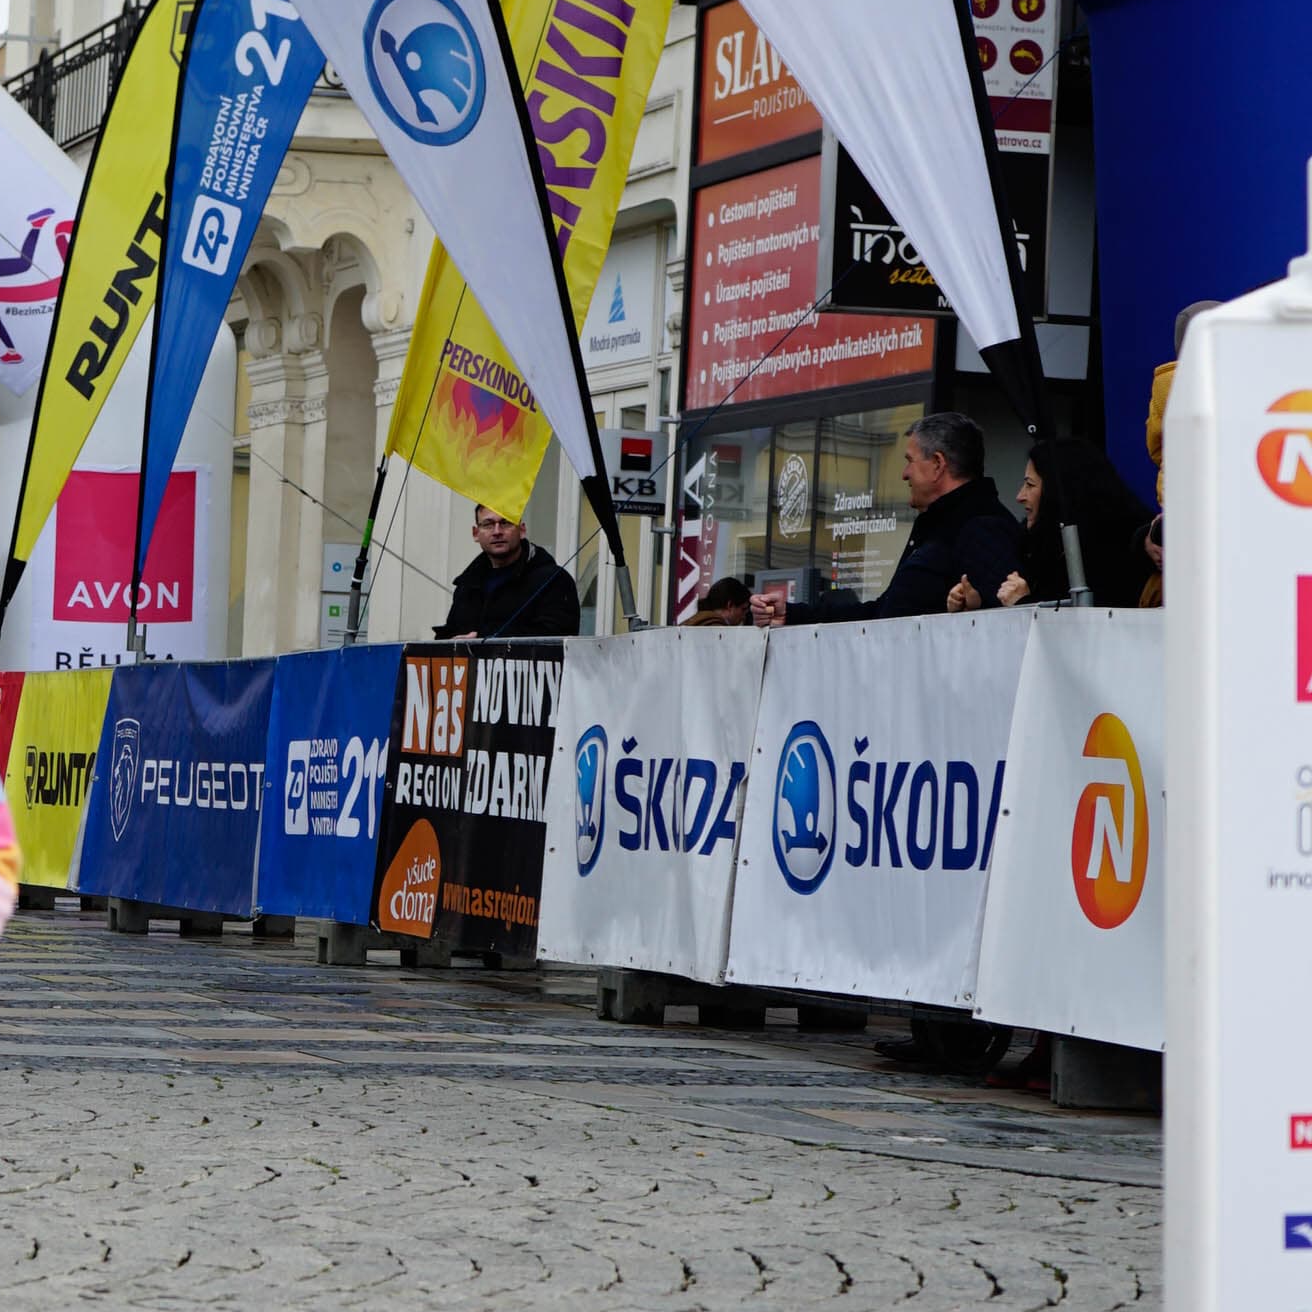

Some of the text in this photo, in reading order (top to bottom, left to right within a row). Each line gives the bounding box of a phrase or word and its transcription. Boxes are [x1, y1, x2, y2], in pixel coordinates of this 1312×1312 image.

[714, 29, 792, 101] SLAV
[200, 95, 233, 189] ZDRAVOTNÍ
[213, 93, 248, 193] POJIŠŤOVNA
[226, 85, 265, 197] MINISTERSTVA
[237, 117, 270, 201] VNITRA ČR
[719, 184, 797, 225] Cestovní pojištění
[717, 234, 755, 265] Pojištění
[755, 221, 809, 255] motorových
[716, 267, 791, 304] Úrazové pojištění
[589, 329, 641, 353] Modrá pyramida
[714, 303, 820, 345] Pojištění pro živnostníky
[440, 338, 537, 413] PERSKINDOL
[711, 323, 923, 384] Pojištění průmyslových a podnikatelských rizik
[612, 476, 657, 496] KB
[834, 489, 873, 511] Zdravotní
[833, 515, 868, 541] pojištění
[67, 581, 179, 609] AVON
[402, 658, 562, 754] Náš NOVINY
[141, 759, 265, 811] PEUGEOT
[395, 748, 547, 823] REGION ZDARM
[614, 736, 746, 857] ŠKODA
[406, 853, 437, 886] všude
[390, 880, 435, 924] doma
